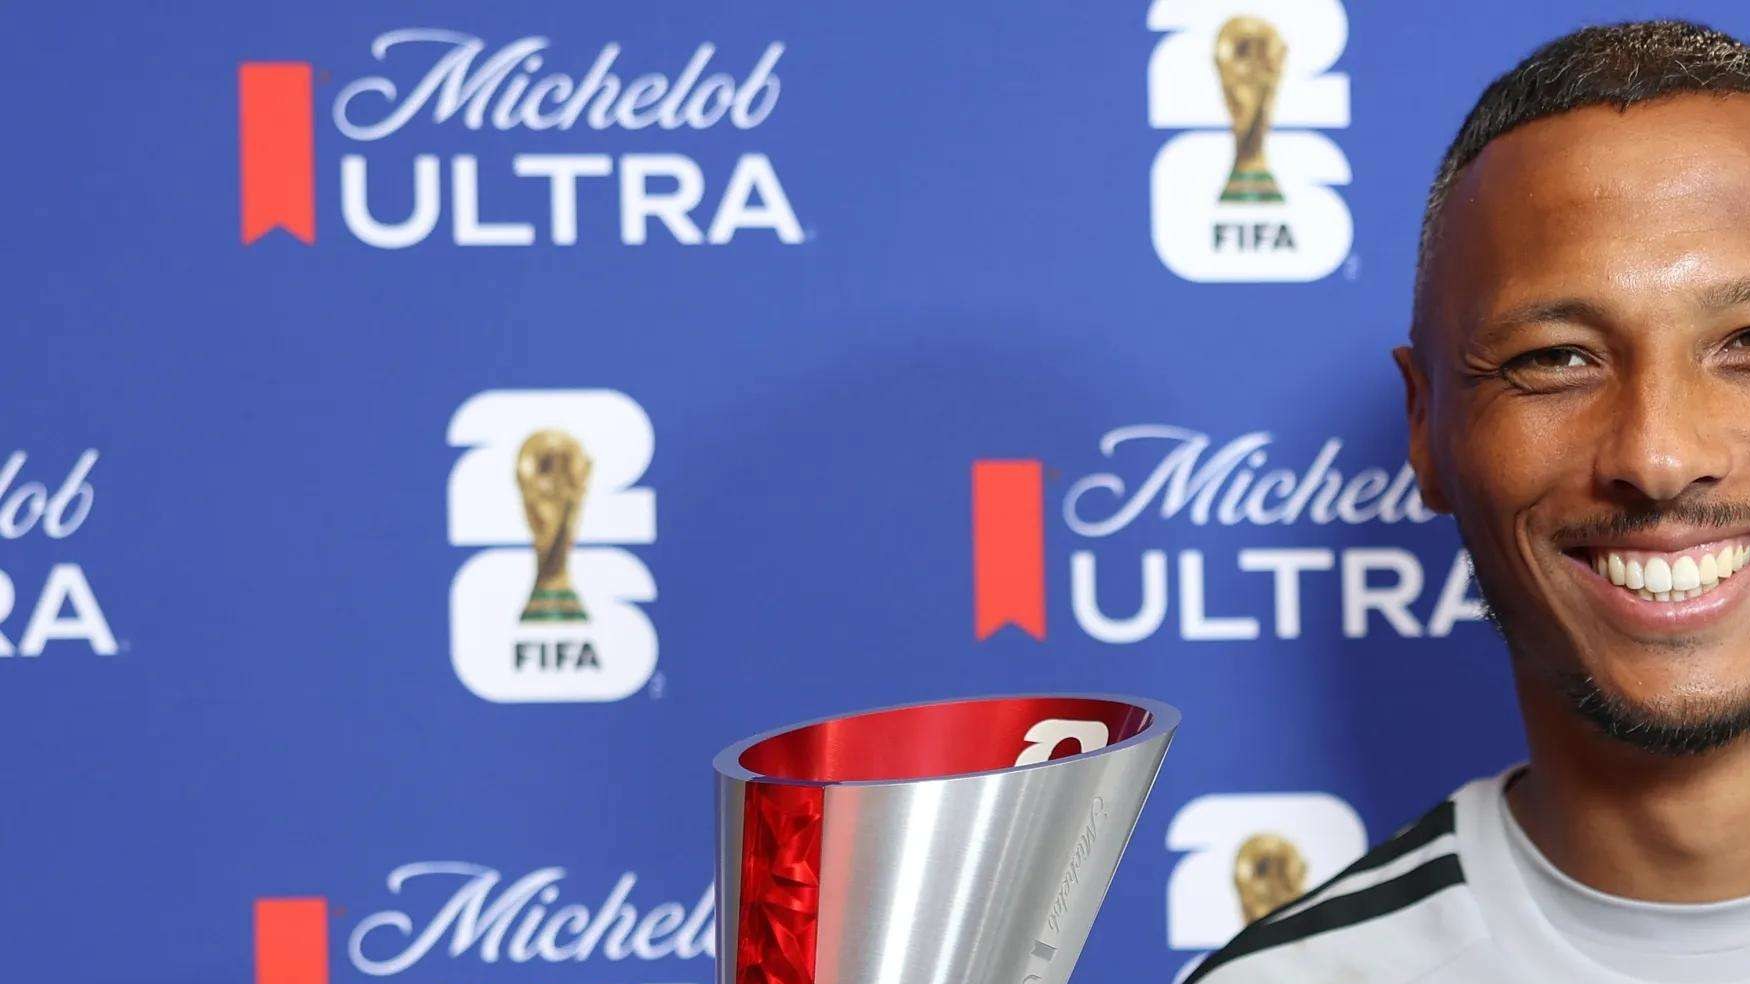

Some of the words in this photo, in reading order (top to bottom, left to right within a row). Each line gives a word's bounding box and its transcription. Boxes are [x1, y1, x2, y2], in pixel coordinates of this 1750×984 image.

[333, 28, 786, 141] Michelob
[340, 153, 806, 249] ULTRA
[1212, 222, 1299, 254] FIFA
[1063, 424, 1438, 538] Michel
[513, 640, 602, 673] FIFA
[348, 861, 716, 977] Michel
